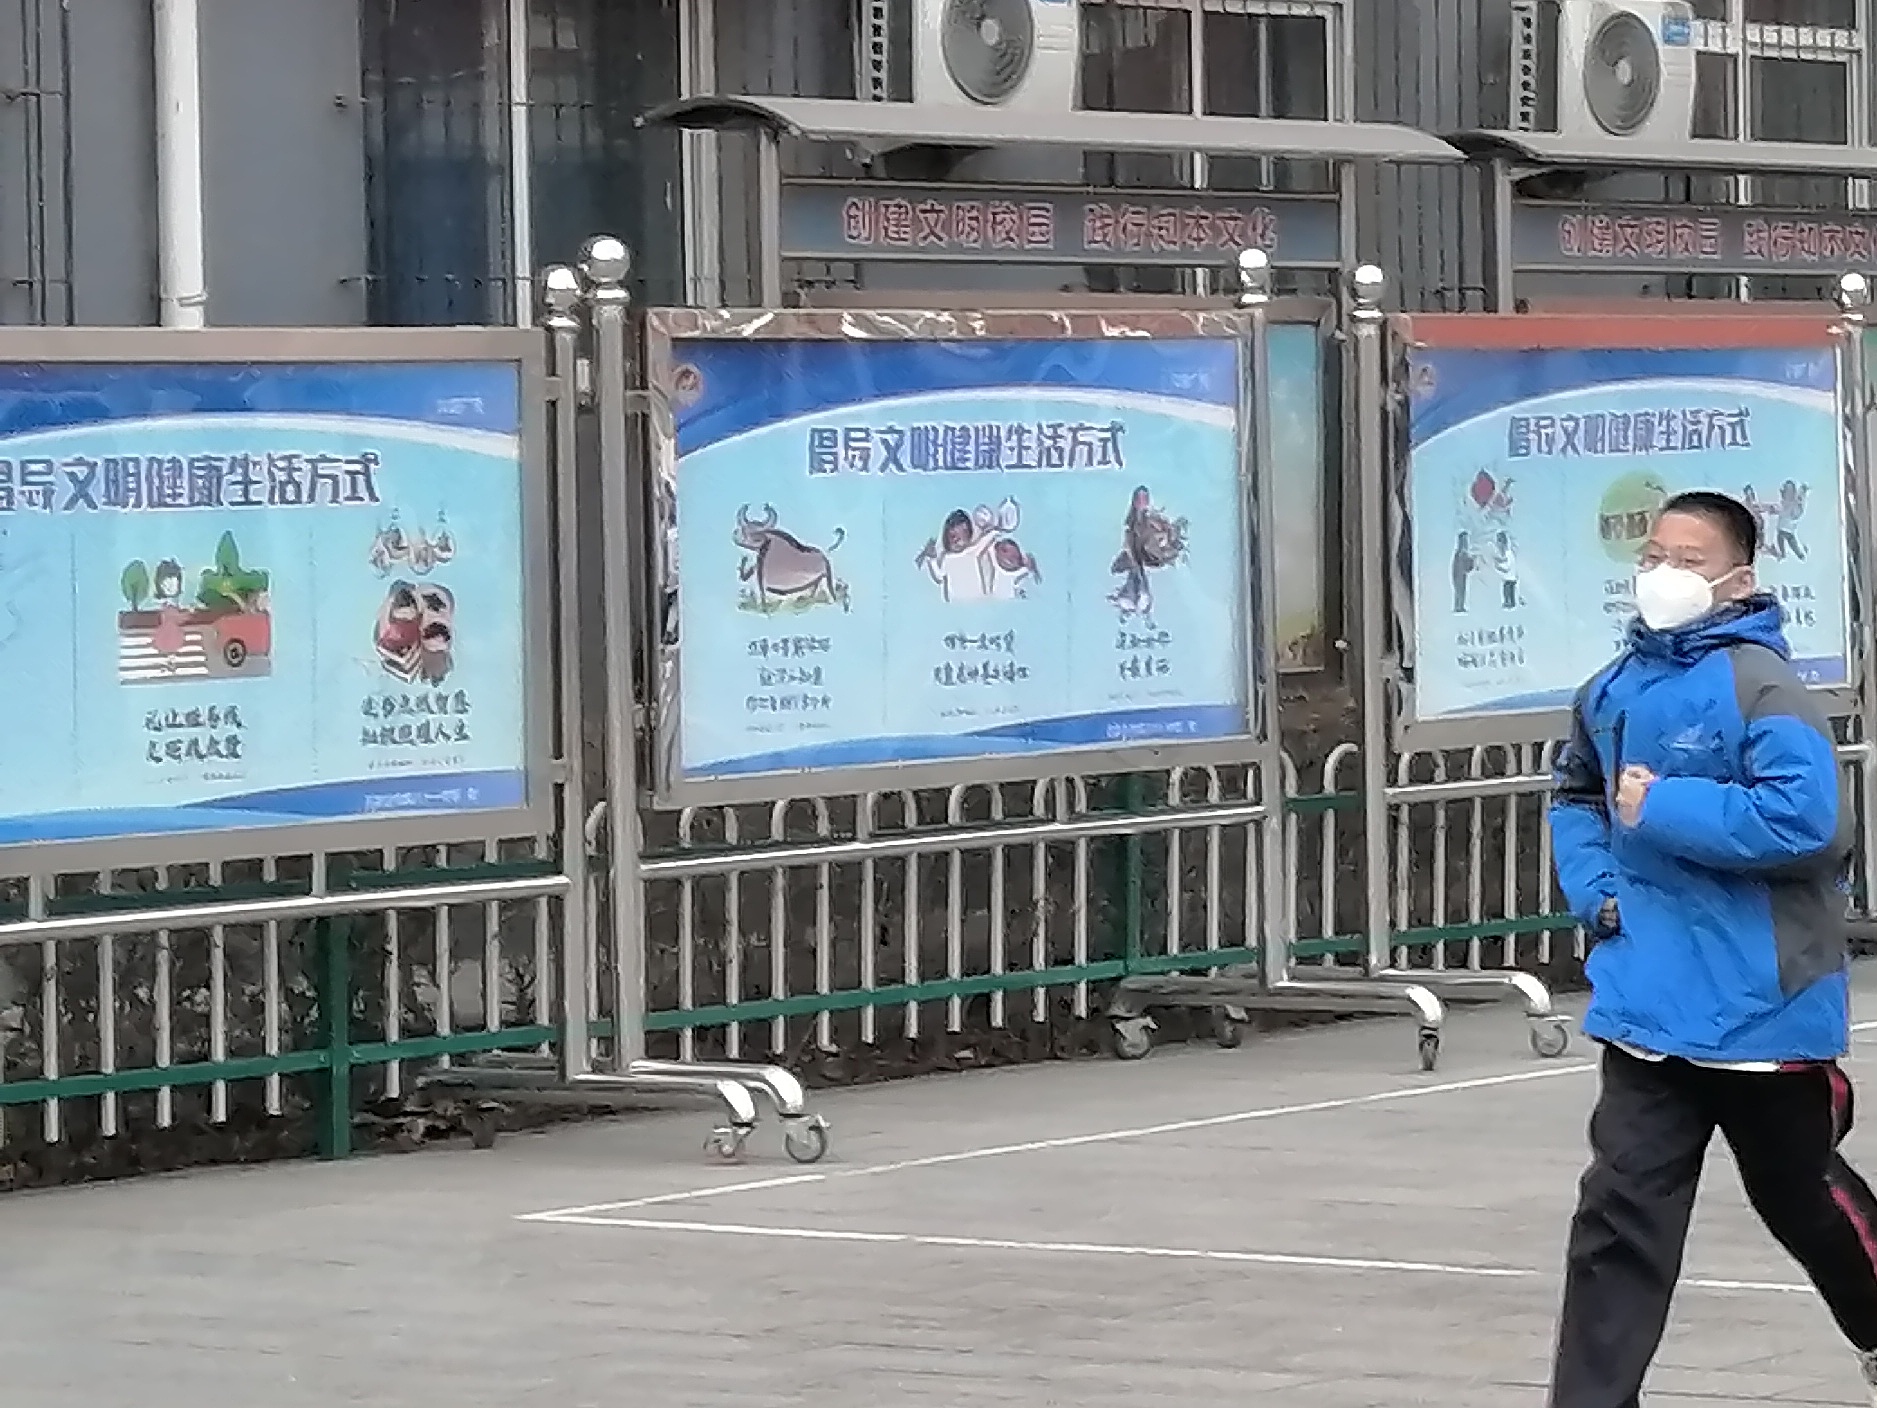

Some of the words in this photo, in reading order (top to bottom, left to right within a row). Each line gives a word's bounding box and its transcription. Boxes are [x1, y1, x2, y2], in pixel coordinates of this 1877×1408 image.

[843, 196, 1053, 250] 创建文明校园
[808, 420, 1125, 476] 倡导文明健康生活方式
[1507, 405, 1752, 460] 倡导文明健康生活方式
